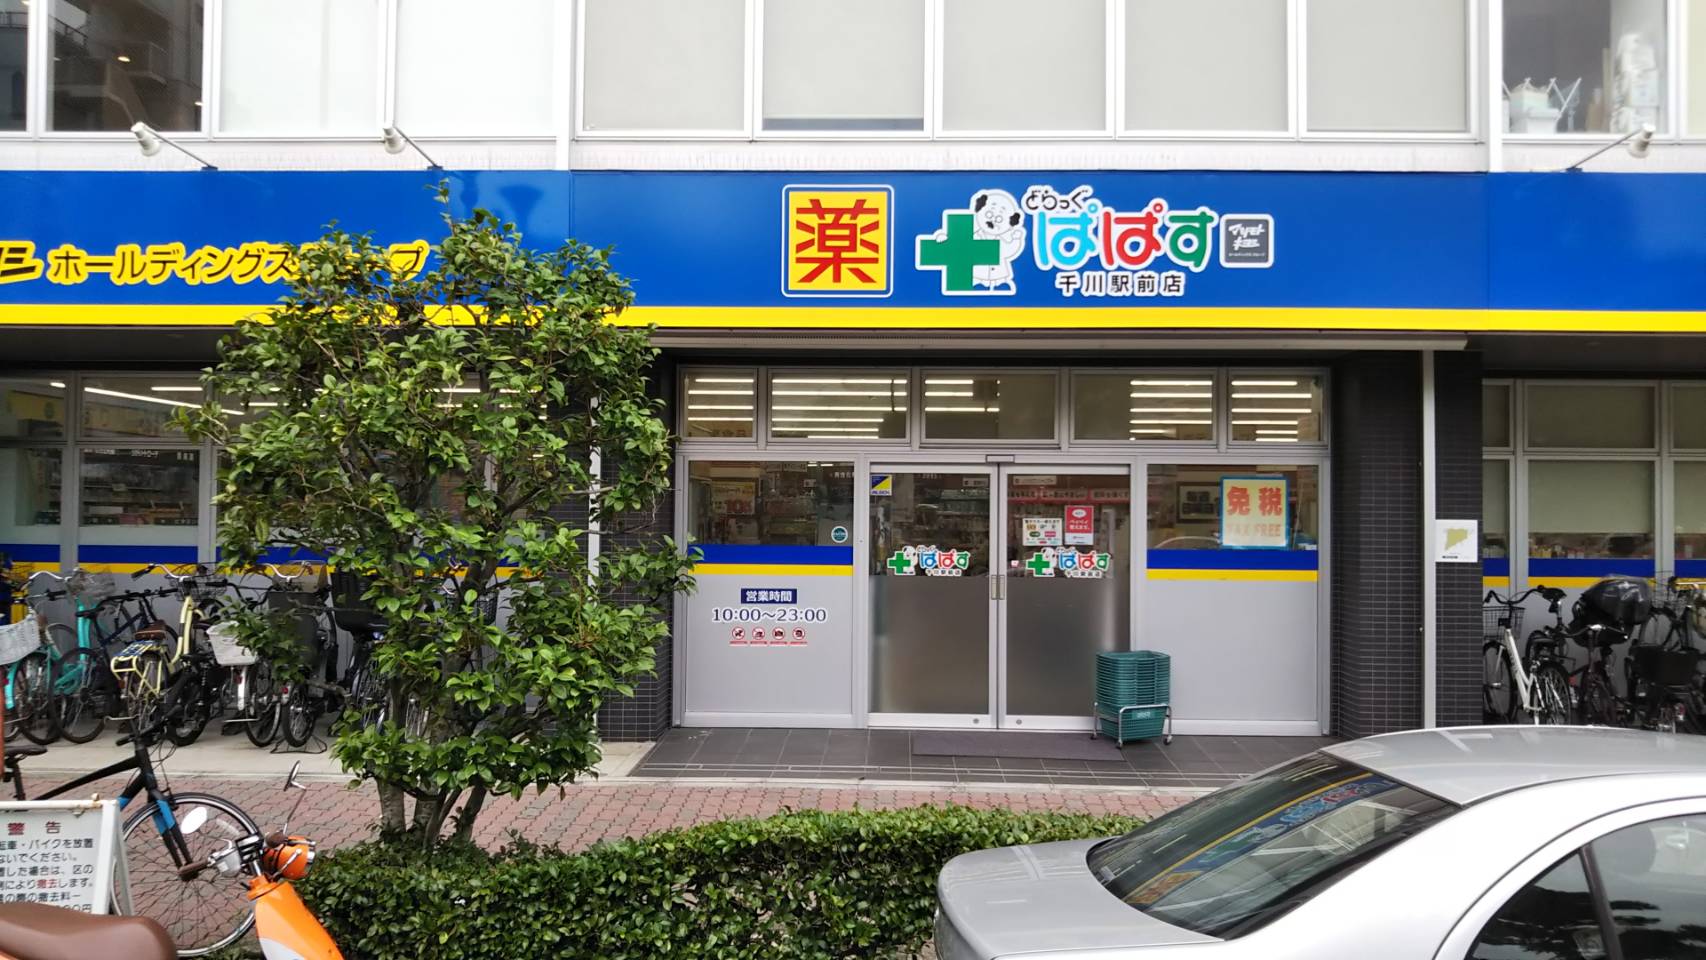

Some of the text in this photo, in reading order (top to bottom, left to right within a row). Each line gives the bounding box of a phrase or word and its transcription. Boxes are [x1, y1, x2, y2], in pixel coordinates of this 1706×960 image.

[796, 199, 878, 282] 薬
[1037, 203, 1214, 267] ぱぱす
[53, 246, 424, 279] ホールディングスプ
[1059, 274, 1182, 294] 千川駅前店
[1227, 486, 1282, 516] 免税
[1254, 523, 1281, 537] FREE
[745, 590, 793, 603] 営業時間
